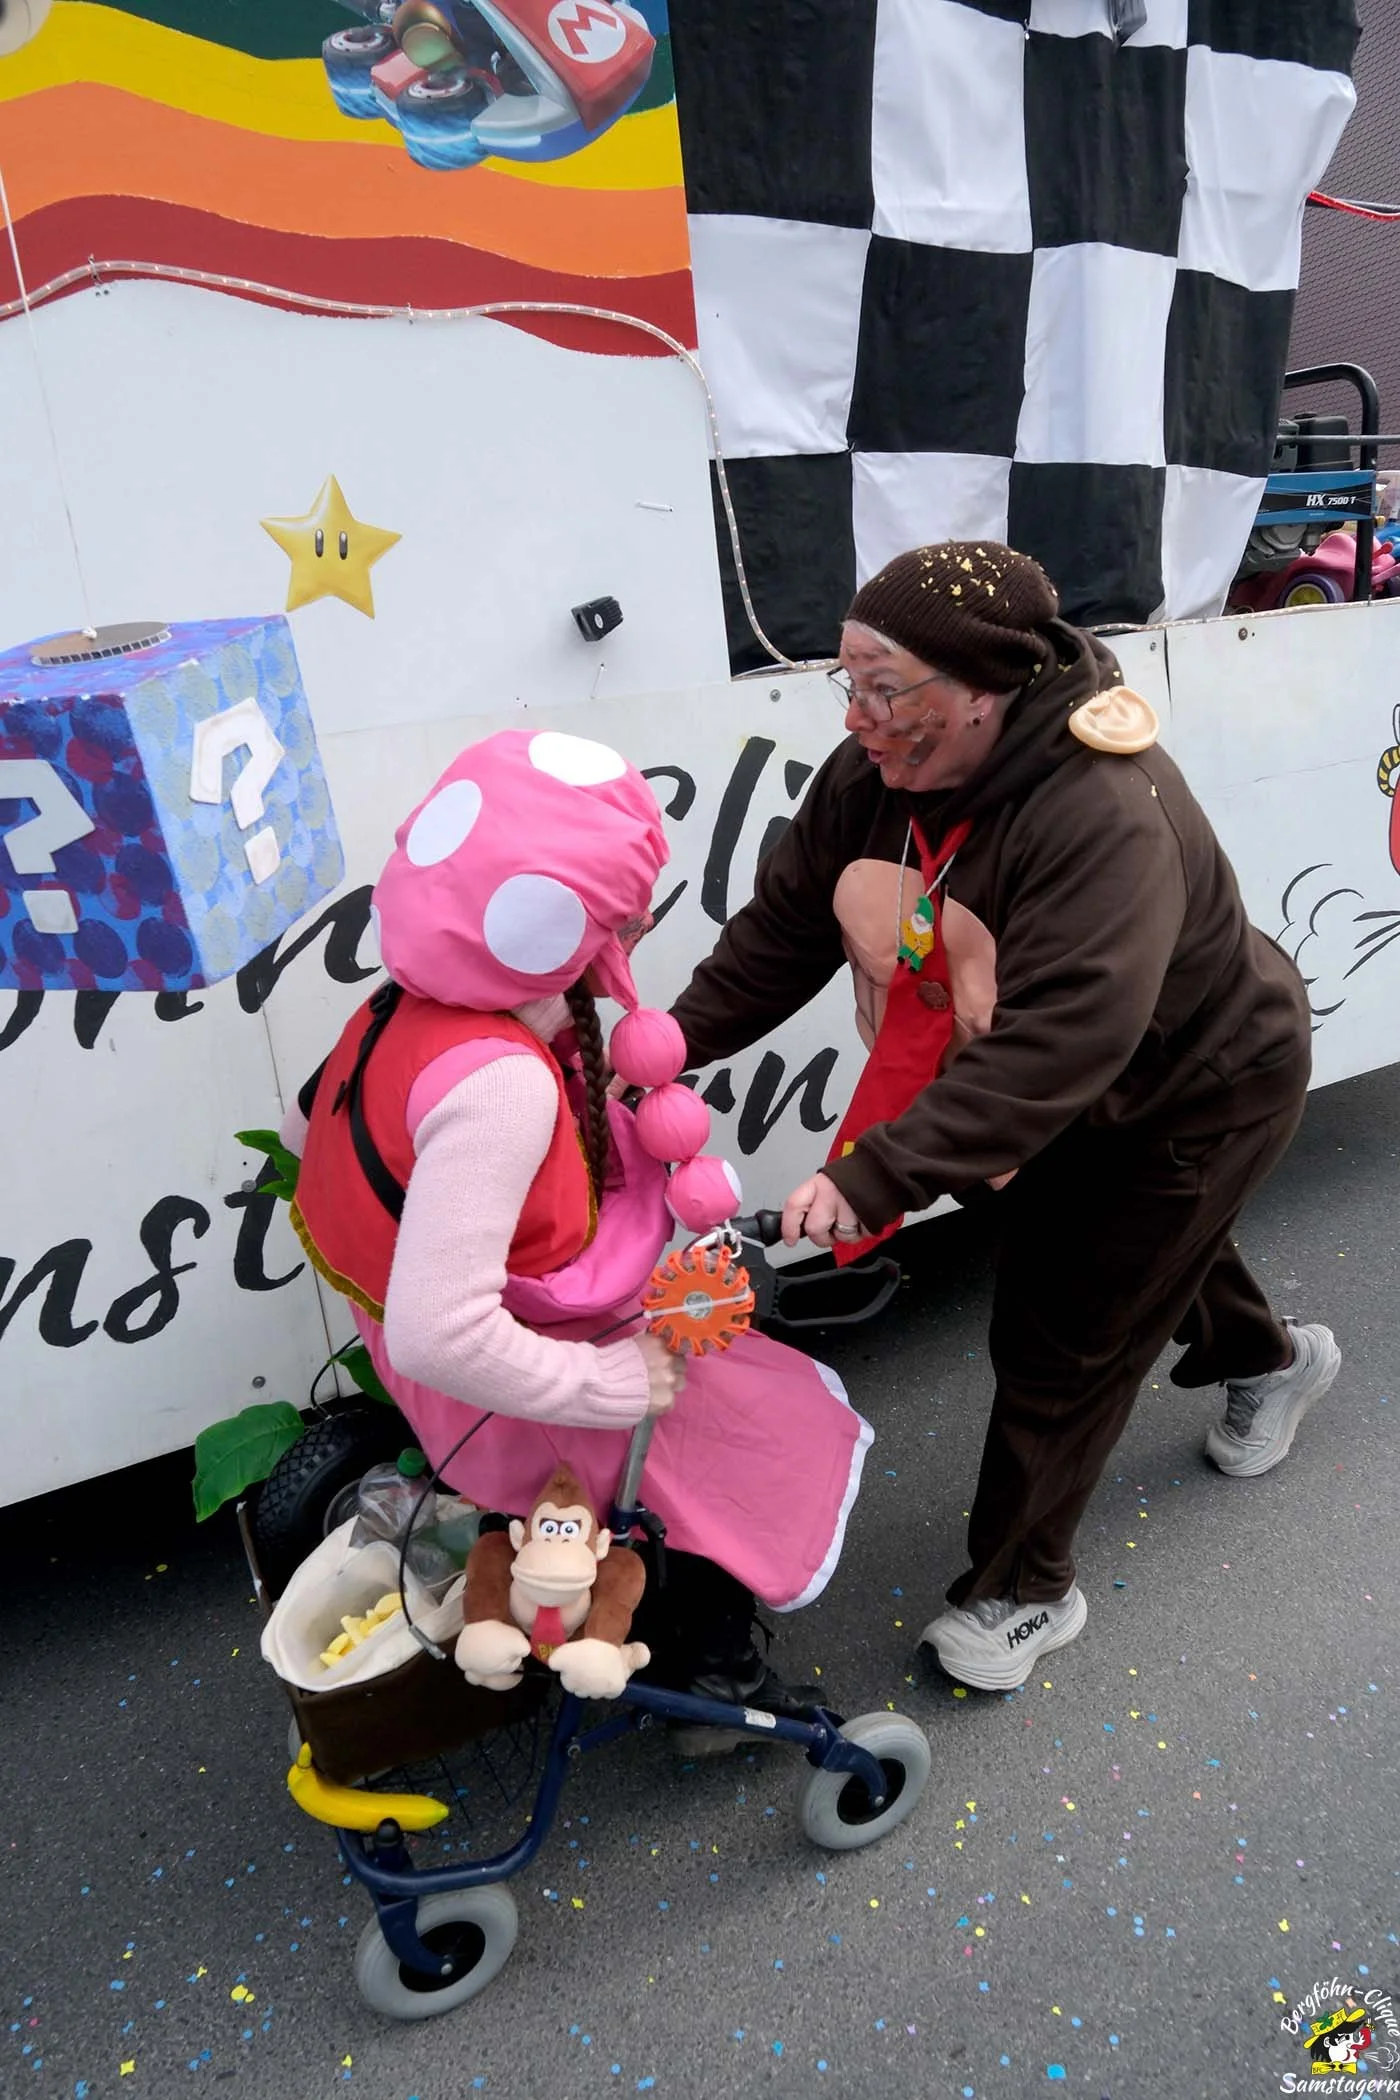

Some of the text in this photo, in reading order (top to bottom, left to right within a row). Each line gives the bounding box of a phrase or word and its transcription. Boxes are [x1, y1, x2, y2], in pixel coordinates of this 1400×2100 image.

[557, 3, 618, 55] M
[1306, 493, 1357, 506] HX 7500 T
[1006, 1611, 1049, 1649] HOKA
